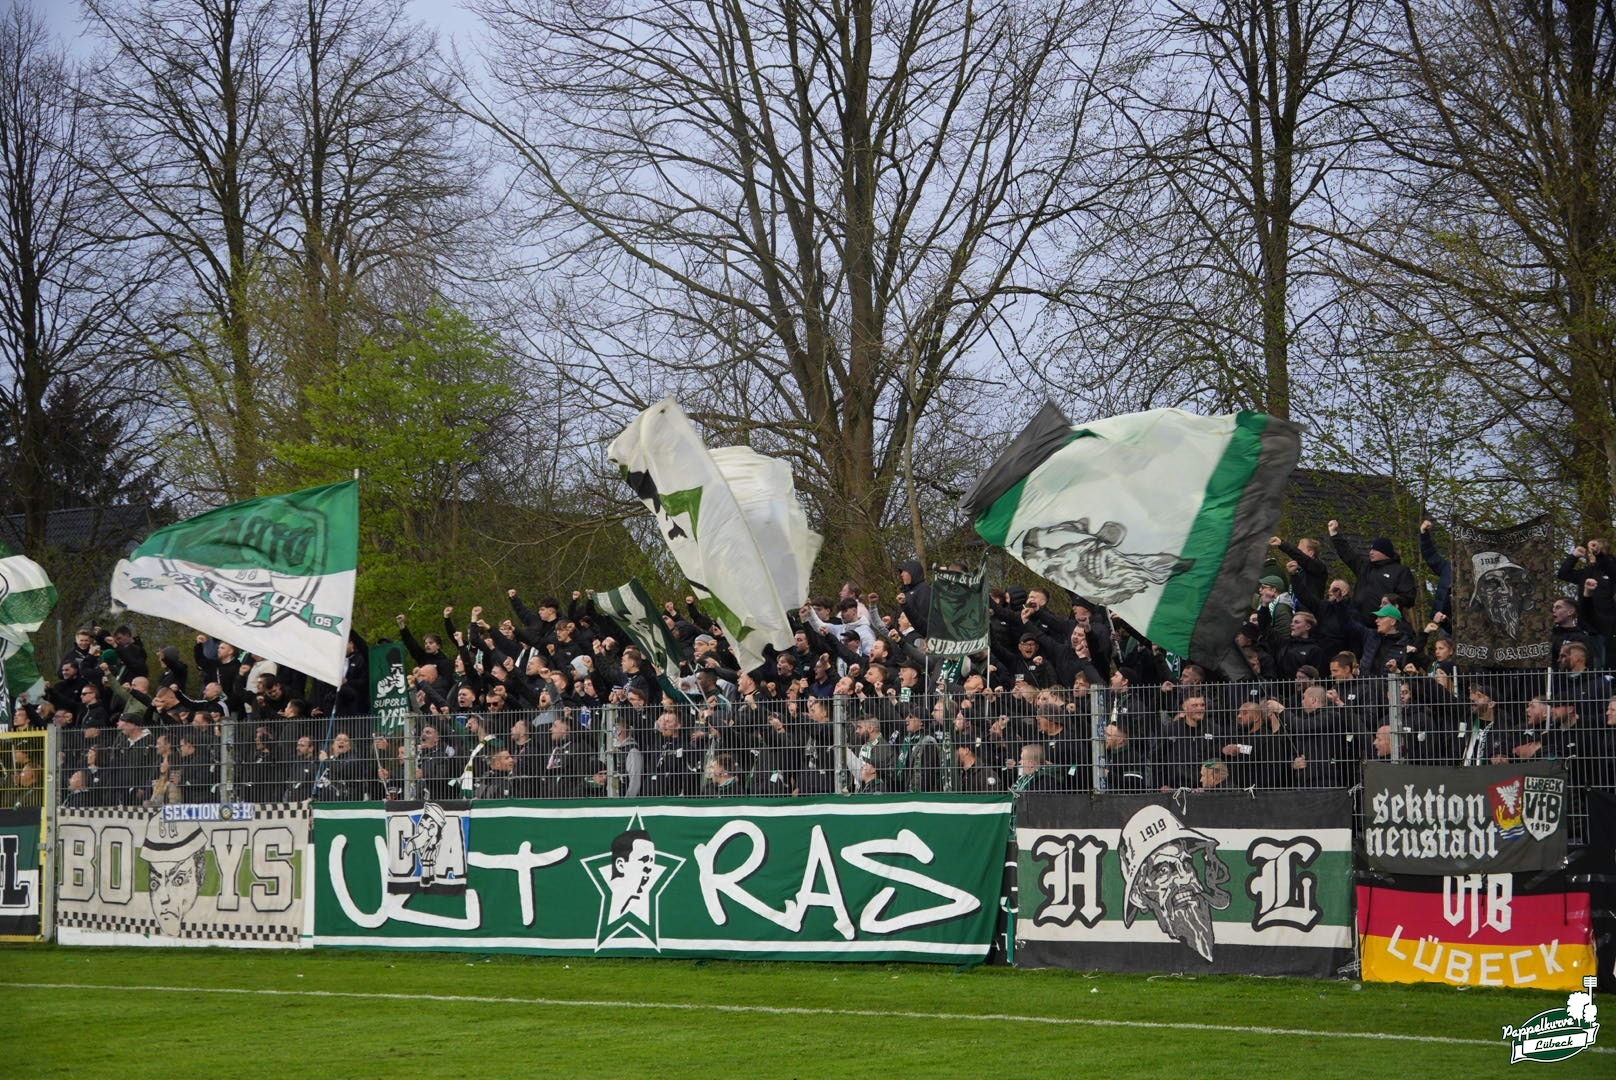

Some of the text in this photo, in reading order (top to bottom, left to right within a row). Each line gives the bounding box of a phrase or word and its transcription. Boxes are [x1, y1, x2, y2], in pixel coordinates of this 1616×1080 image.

[1525, 777, 1563, 792] LÜBECK
[165, 804, 220, 821] SEKTION
[1525, 792, 1562, 824] VfB
[1140, 818, 1168, 843] 1919
[1529, 822, 1550, 833] 1919
[58, 824, 294, 912] BOYS
[1387, 925, 1564, 986] LÜBECK
